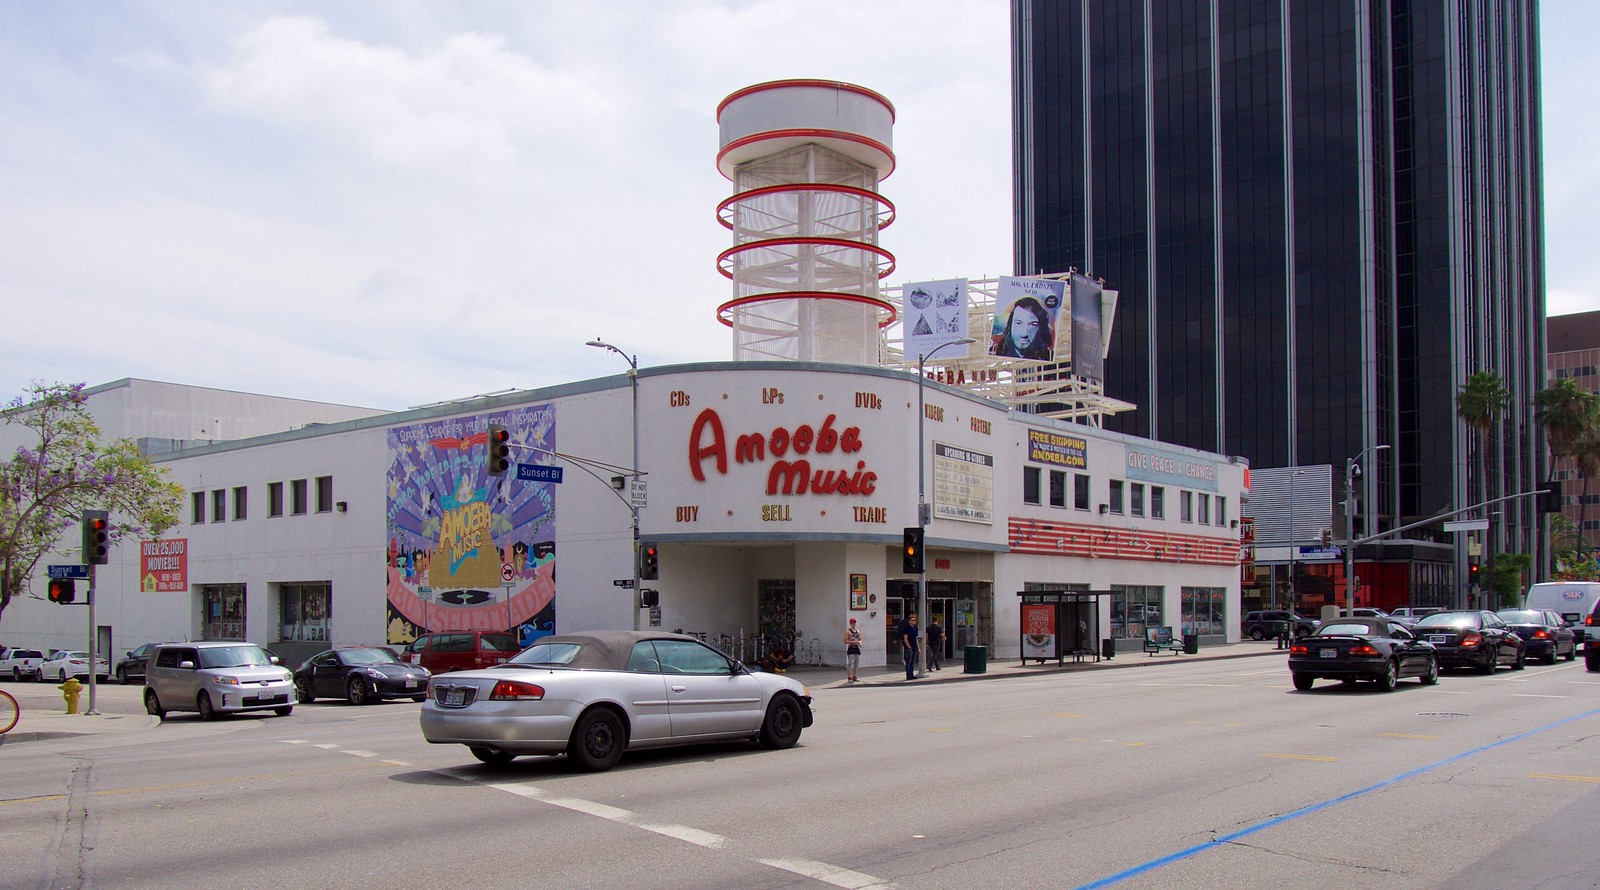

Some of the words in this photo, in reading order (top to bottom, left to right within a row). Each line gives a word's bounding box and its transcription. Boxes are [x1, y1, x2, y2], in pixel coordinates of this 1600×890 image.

[670, 391, 690, 407] CDs
[762, 388, 784, 404] LPs
[855, 391, 882, 409] DVDs
[924, 403, 945, 422] VIDEOS
[689, 407, 863, 482] Amoeba
[1030, 431, 1049, 443] FREE
[1051, 435, 1085, 450] SHIPPING
[1032, 449, 1084, 467] AMOEBA.COM
[1128, 451, 1147, 469] GIVE
[1151, 454, 1174, 474] PEACE
[1177, 460, 1182, 476] A
[521, 466, 549, 478] Sunset
[551, 469, 560, 479] Bl
[766, 459, 878, 496] Music
[676, 505, 698, 522] BUY
[762, 504, 792, 521] SELL
[853, 506, 887, 523] TRADE
[438, 501, 492, 553] AMOEBA
[143, 543, 160, 556] OVER
[161, 541, 184, 556] 25,000
[453, 530, 482, 564] MUSIC
[50, 565, 72, 573] Sunset
[147, 556, 180, 571] MOVIES!!!
